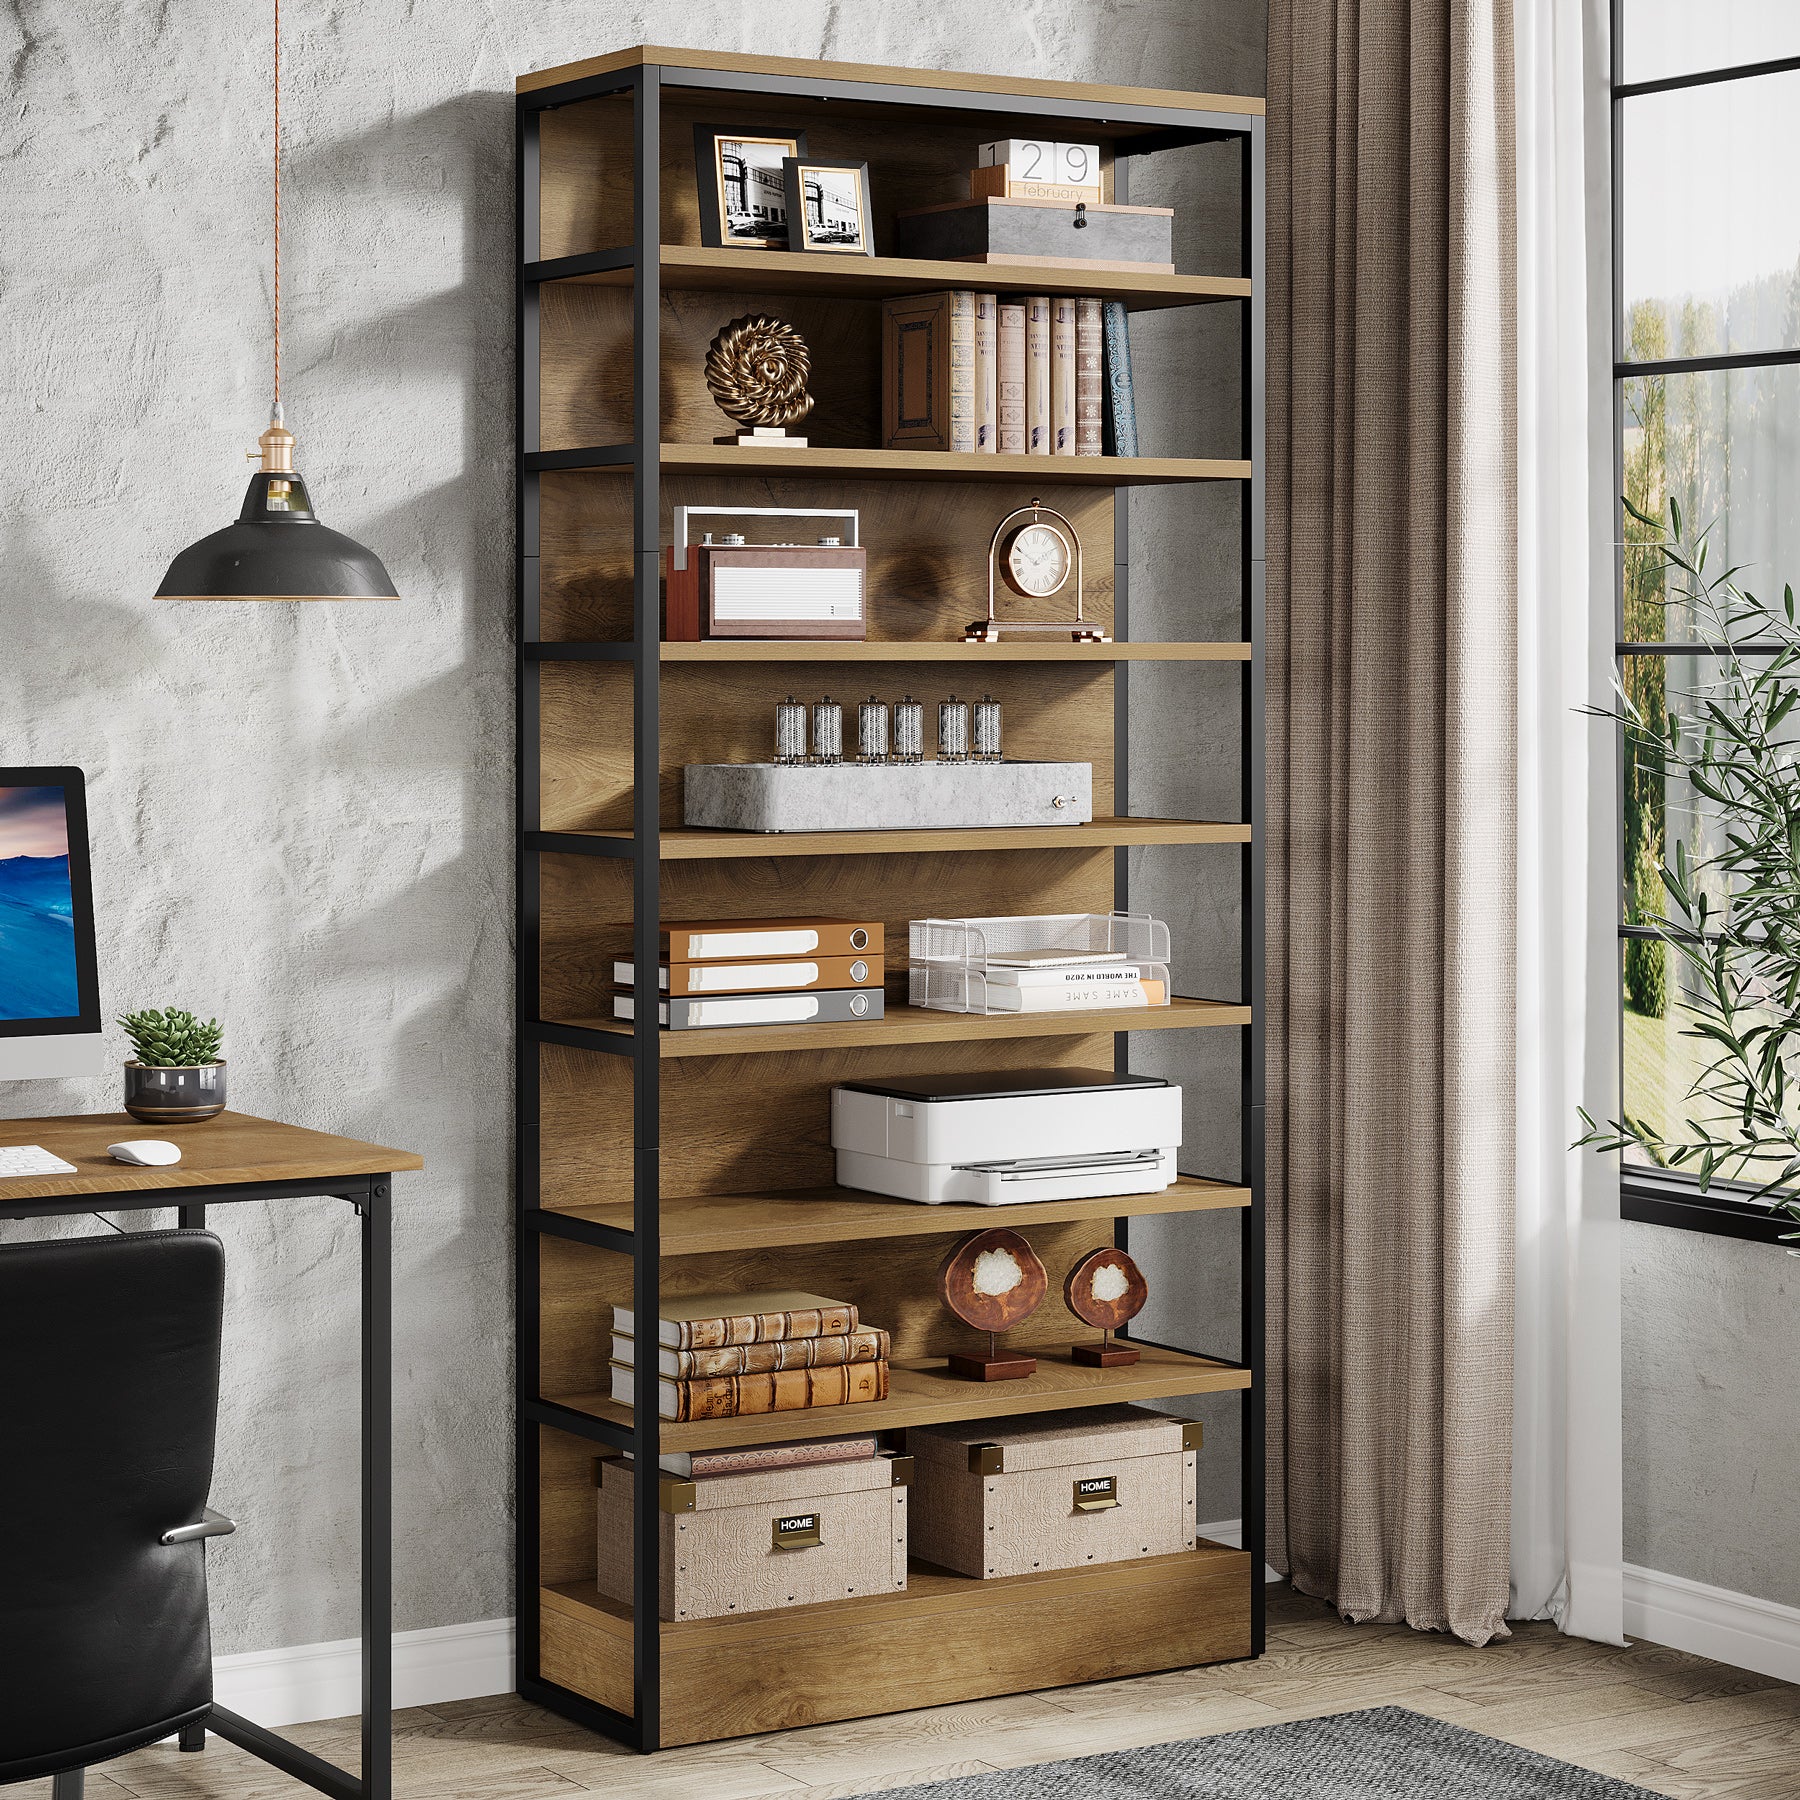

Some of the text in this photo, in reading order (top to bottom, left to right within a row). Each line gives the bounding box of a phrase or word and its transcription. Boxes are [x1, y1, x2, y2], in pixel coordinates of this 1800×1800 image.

[1023, 183, 1083, 202] february
[1096, 972, 1123, 980] WORLD
[1065, 989, 1138, 1001] SAME SAME
[1080, 1480, 1111, 1492] HOME
[780, 1517, 814, 1530] HOME
